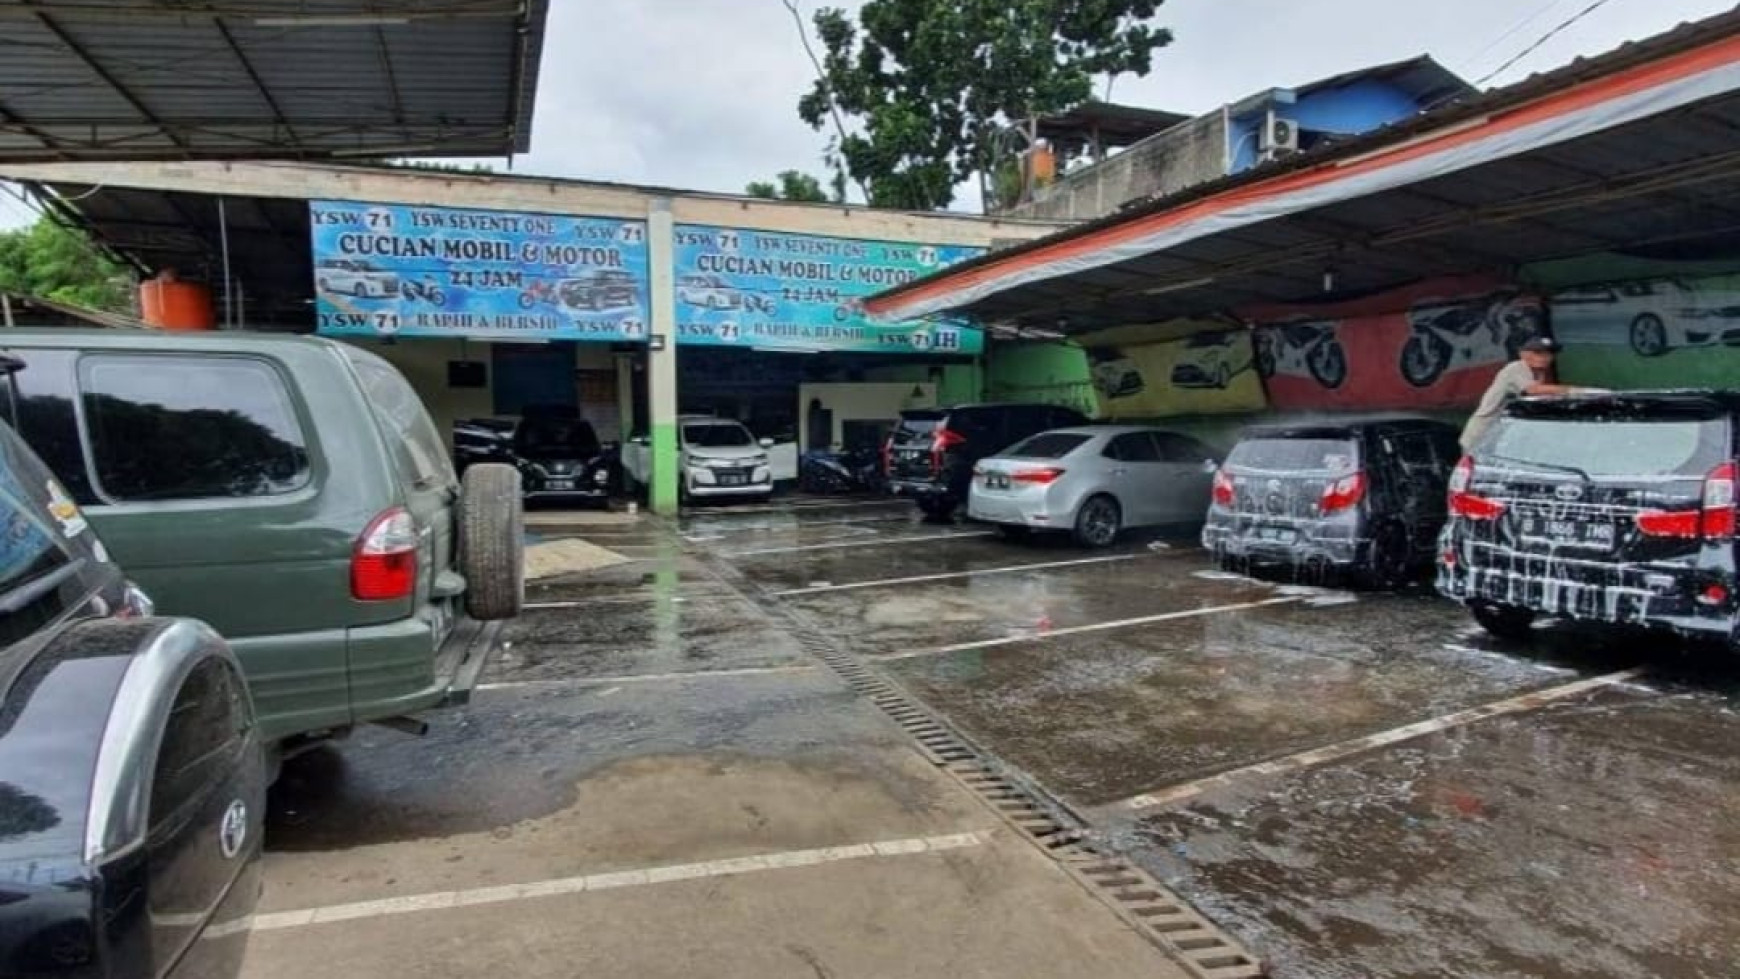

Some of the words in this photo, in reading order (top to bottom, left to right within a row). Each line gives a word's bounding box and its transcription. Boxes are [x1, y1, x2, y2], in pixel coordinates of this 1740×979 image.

[312, 210, 360, 225] YSW
[368, 213, 391, 227] 71
[412, 211, 444, 227] YSW
[450, 213, 519, 233] SEVENTY
[524, 218, 556, 234] ONE
[574, 225, 616, 239] YSW
[623, 227, 642, 240] 71
[675, 231, 713, 245] YSW
[720, 234, 739, 248] 71
[340, 234, 436, 257] CUCIAN
[444, 239, 516, 261] MOBIL
[522, 242, 538, 262] &
[546, 245, 622, 267] MOTOR
[920, 249, 935, 262] 71
[697, 255, 773, 275] CUCIAN
[780, 261, 834, 281] MOBIL
[451, 270, 473, 287] 24
[479, 270, 523, 287] JAM
[804, 286, 839, 302] JAM
[320, 313, 367, 327] YSW
[375, 313, 398, 328] 71
[575, 319, 616, 333] YSW
[623, 320, 643, 334] 71
[678, 324, 713, 336] YSW
[721, 324, 739, 337] 71
